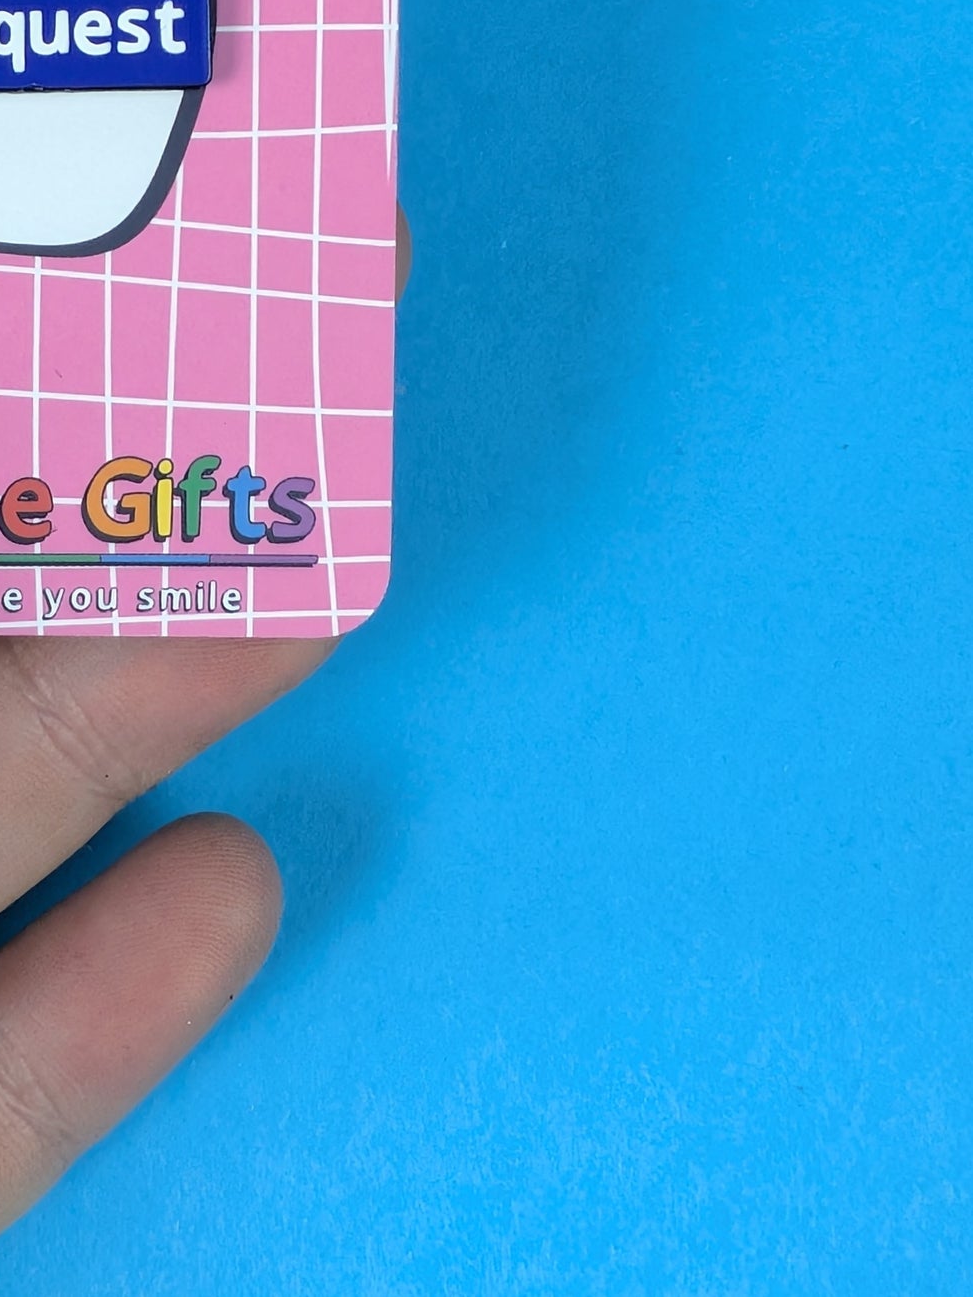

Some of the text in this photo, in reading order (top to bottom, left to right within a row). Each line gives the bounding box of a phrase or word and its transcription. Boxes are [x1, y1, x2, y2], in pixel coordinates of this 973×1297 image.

[82, 454, 317, 544] Gifts
[42, 586, 117, 620] you
[136, 580, 243, 614] smile
